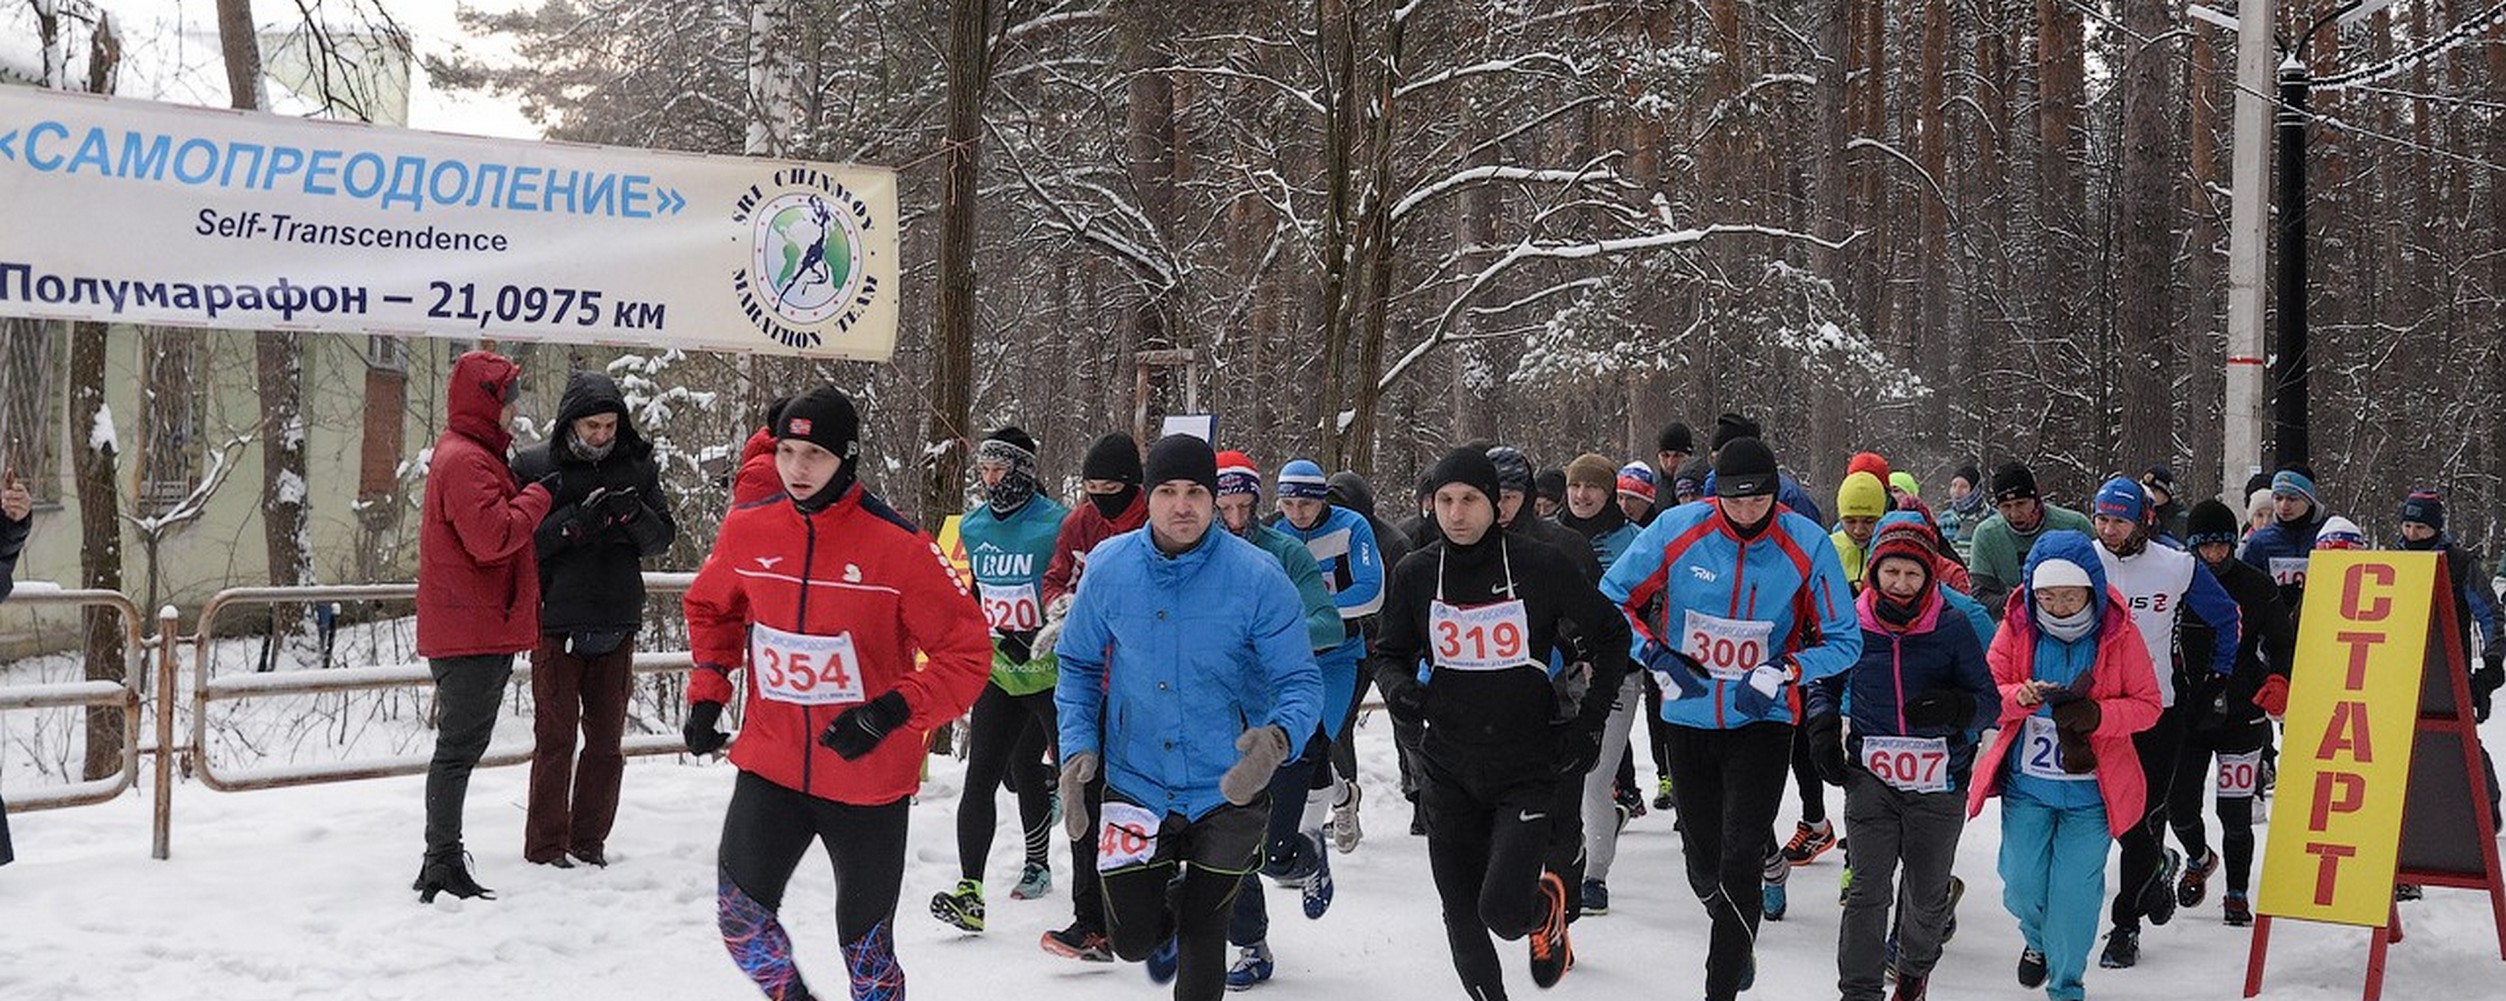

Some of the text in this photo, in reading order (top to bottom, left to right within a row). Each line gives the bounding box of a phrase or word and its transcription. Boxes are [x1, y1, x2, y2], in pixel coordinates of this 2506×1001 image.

[731, 168, 877, 232] SRI CHINMOY
[195, 208, 509, 252] Self-Transcendence
[0, 263, 368, 322] Полумарафон
[426, 281, 602, 329] 21,0975
[613, 301, 666, 330] км
[732, 267, 879, 349] MARATHON TEAM
[984, 597, 1036, 632] 520
[1438, 621, 1521, 660] 319
[1691, 631, 1760, 671] 300
[764, 647, 851, 693] 354
[2305, 562, 2397, 908] СТАРТ
[1870, 750, 1945, 783] 607
